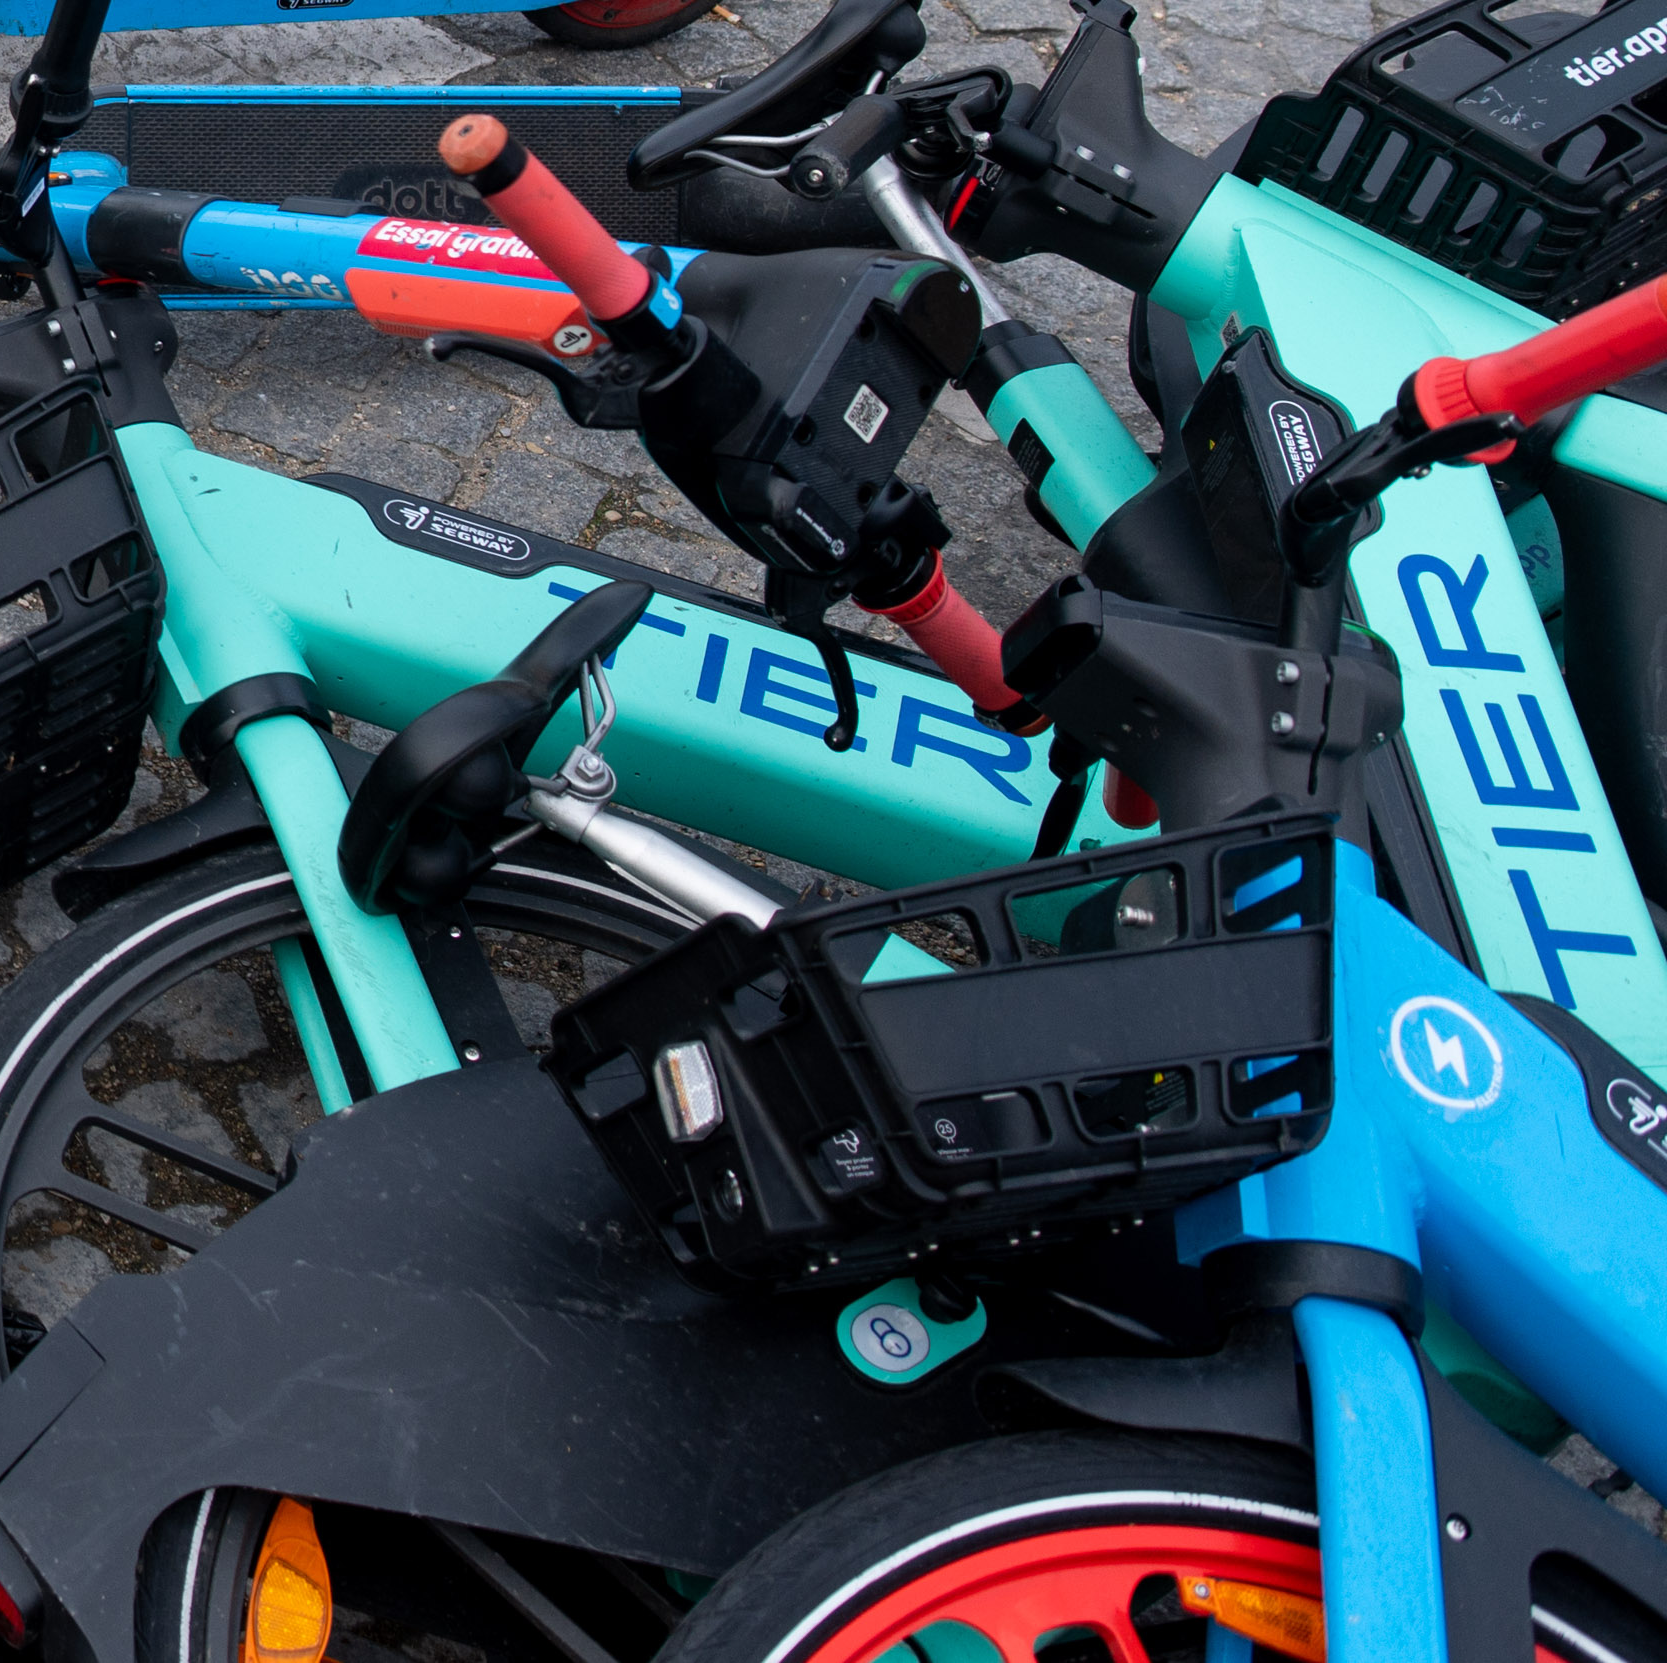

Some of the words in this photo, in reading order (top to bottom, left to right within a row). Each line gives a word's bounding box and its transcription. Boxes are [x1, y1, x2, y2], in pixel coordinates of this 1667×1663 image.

[375, 220, 459, 248] Essai
[1276, 414, 1292, 430] BY
[430, 523, 515, 554] SEGWAY
[432, 515, 496, 540] POWERED
[497, 536, 516, 546] BY
[1397, 553, 1638, 1011] TIER
[939, 1123, 953, 1135] 25
